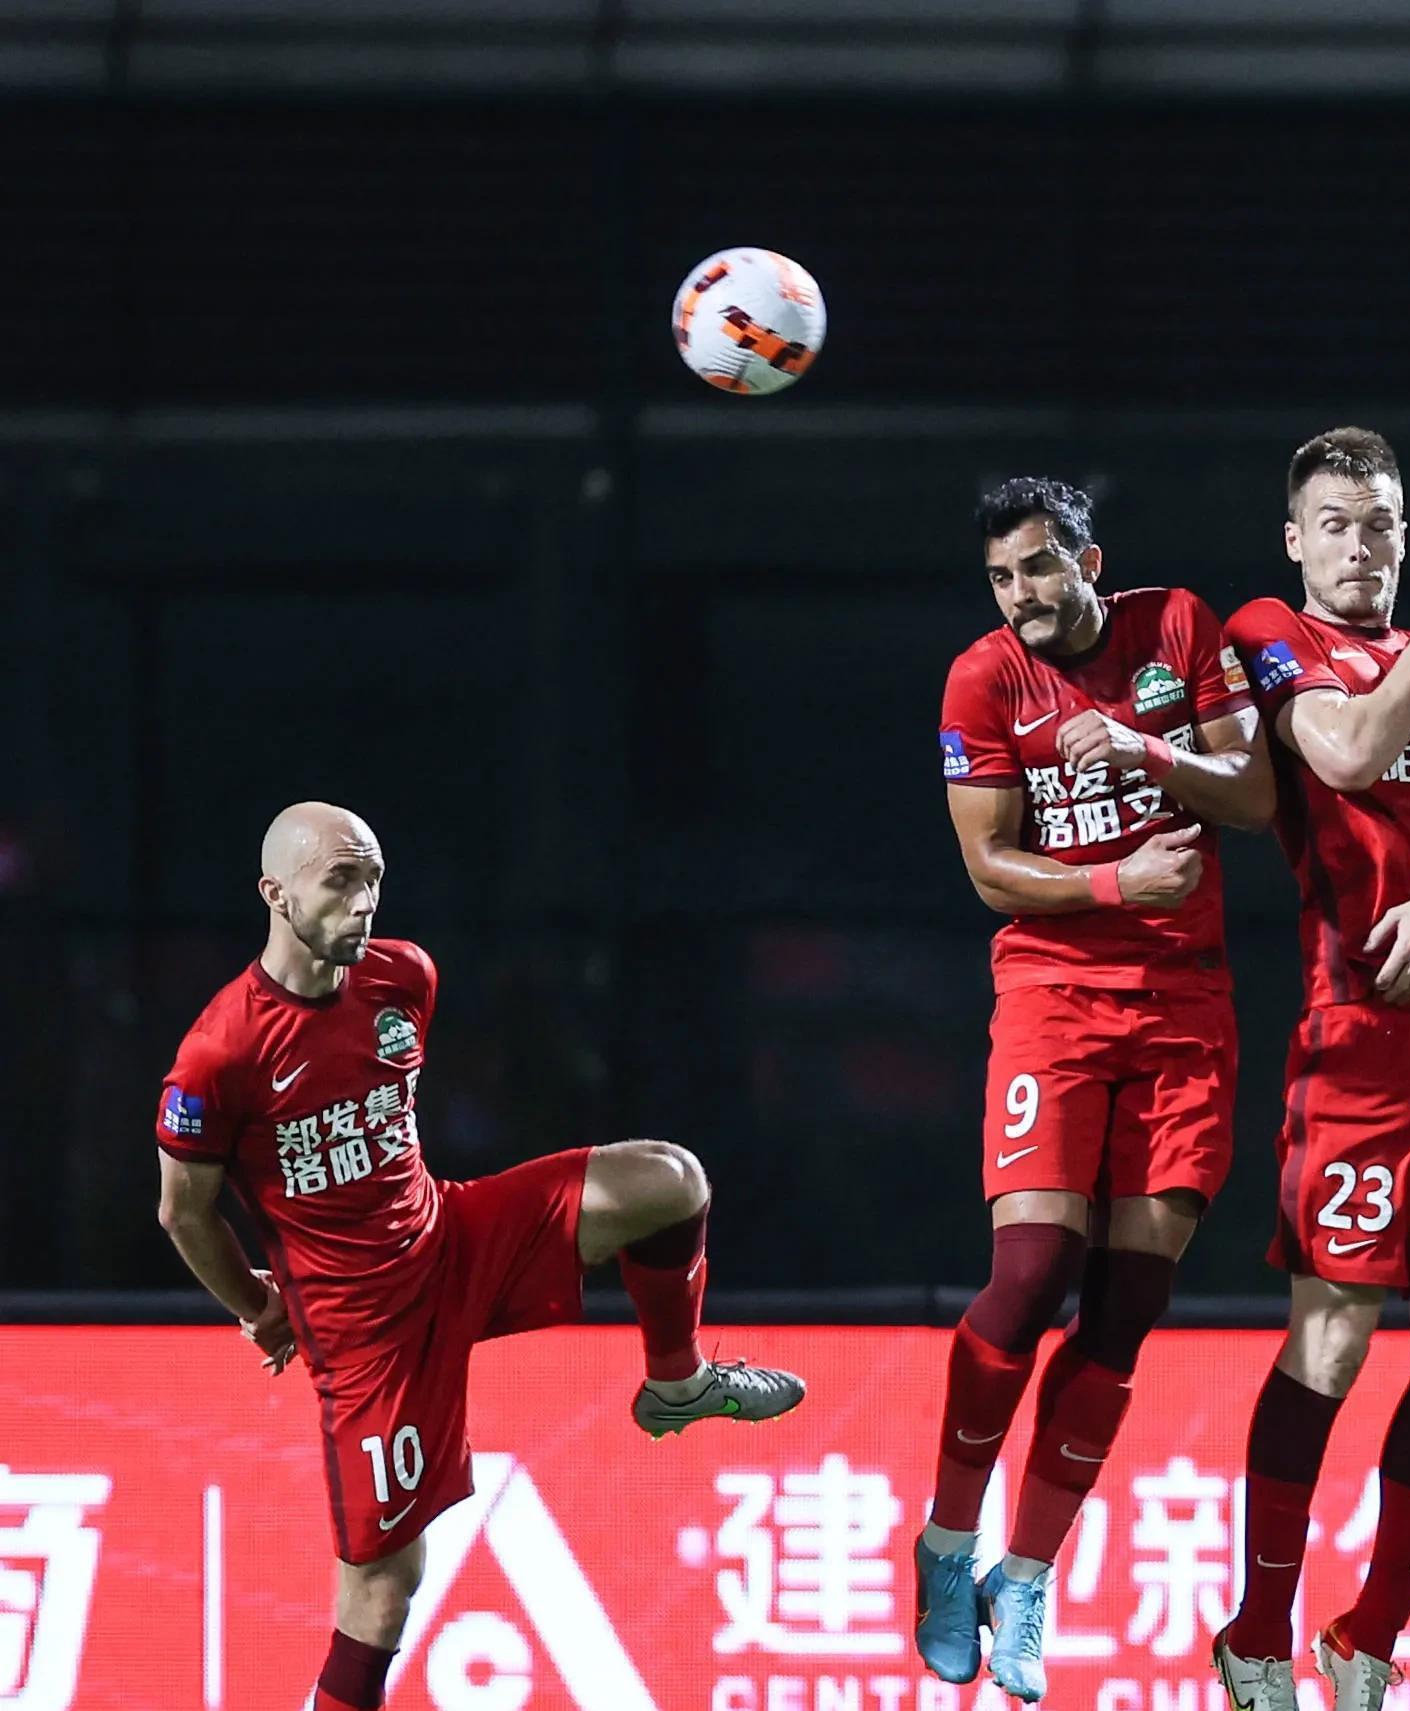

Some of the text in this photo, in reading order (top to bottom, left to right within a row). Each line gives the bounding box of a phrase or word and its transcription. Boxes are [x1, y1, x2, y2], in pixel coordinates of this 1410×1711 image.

[1025, 723, 1197, 804] 郑发团
[1034, 785, 1183, 848] 洛阳文
[1004, 1073, 1040, 1139] 9
[1317, 1161, 1394, 1232] 23
[361, 1425, 424, 1503] 10
[711, 1675, 1041, 1711] CENTRA
